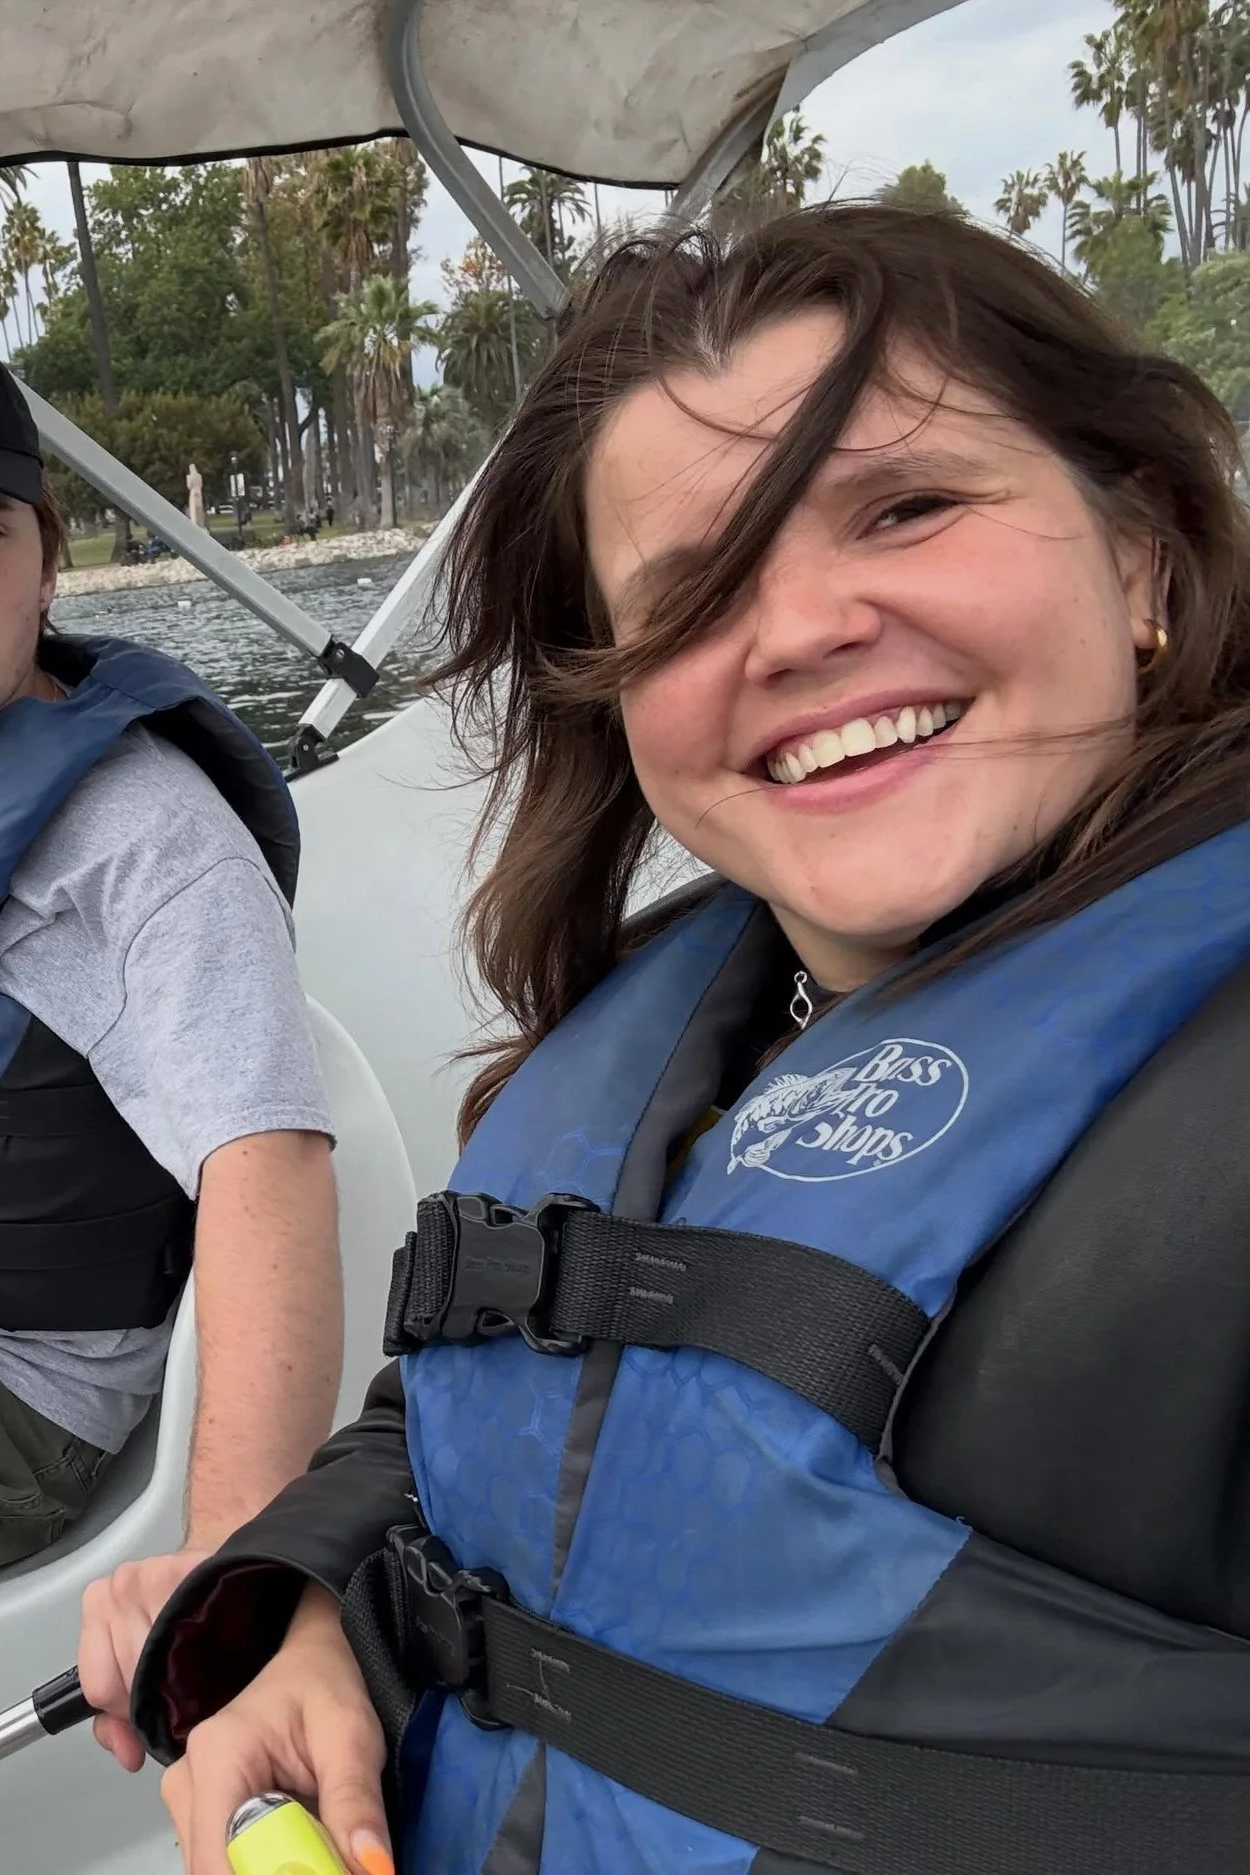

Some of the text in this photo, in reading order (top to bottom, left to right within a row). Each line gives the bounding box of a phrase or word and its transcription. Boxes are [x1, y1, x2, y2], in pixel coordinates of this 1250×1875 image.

[853, 1043, 952, 1087] Bass
[840, 1082, 899, 1118] Pro
[795, 1114, 914, 1166] Shops
